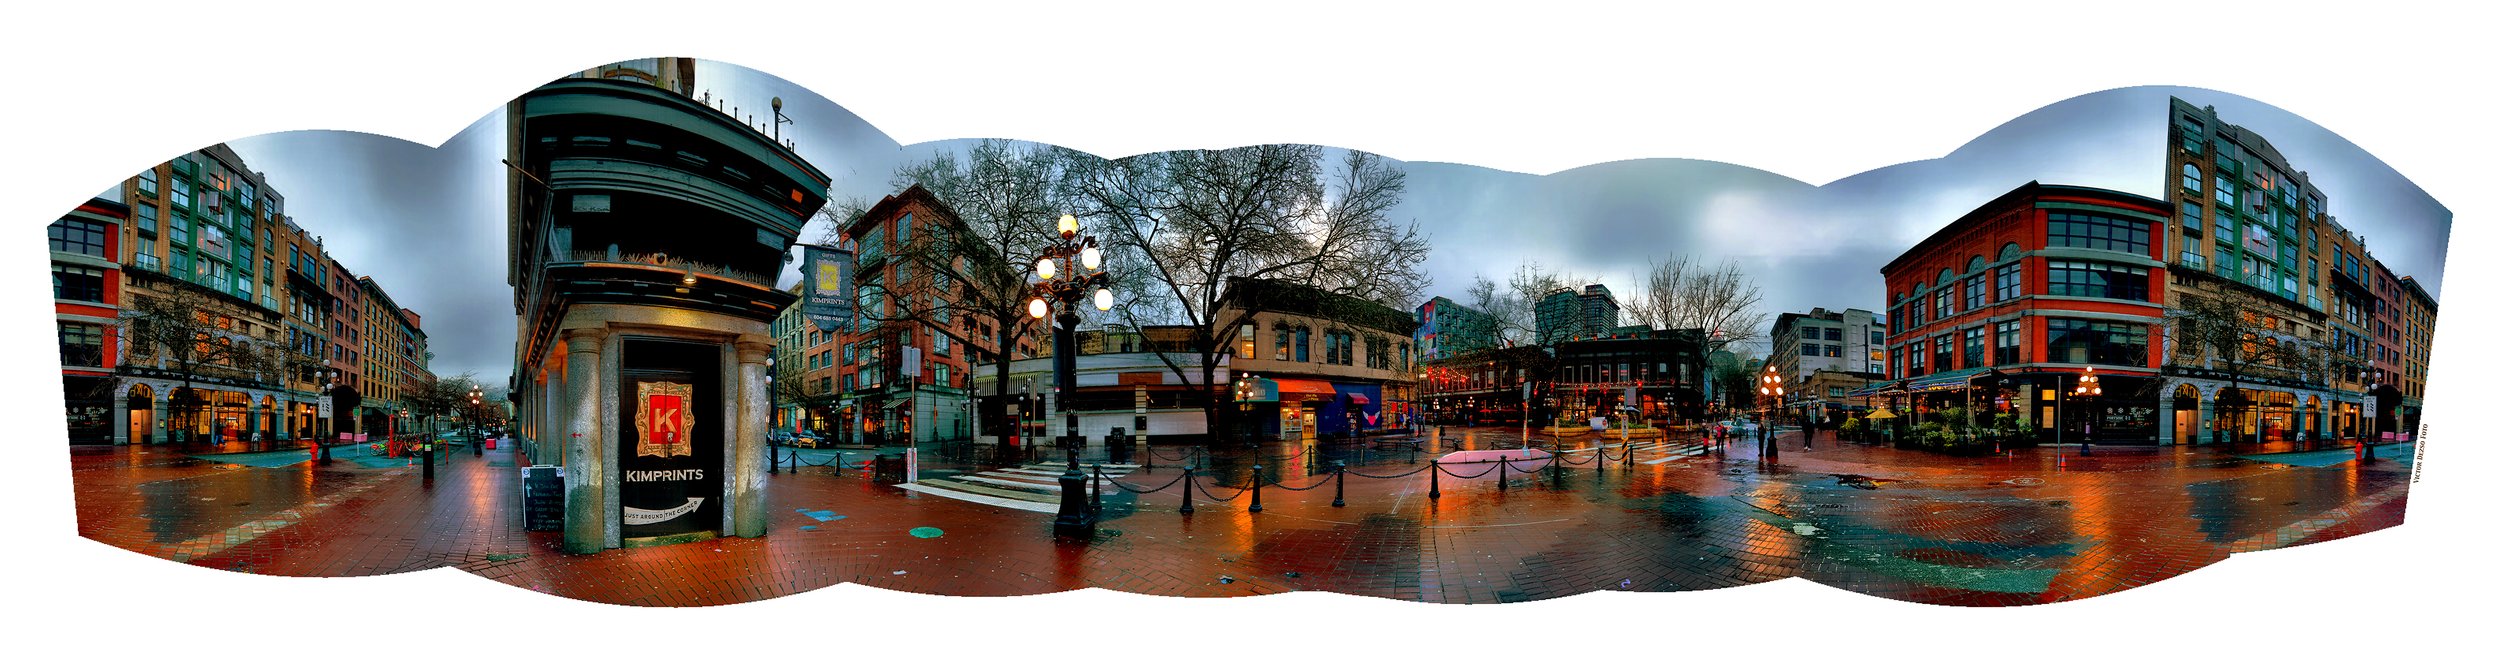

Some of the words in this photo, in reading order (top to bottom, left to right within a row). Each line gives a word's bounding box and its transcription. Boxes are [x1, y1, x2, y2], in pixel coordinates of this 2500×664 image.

[823, 271, 834, 284] K
[812, 297, 844, 305] KIMPRINTS
[654, 408, 678, 432] K
[626, 469, 704, 482] KIMPRINTS
[677, 501, 698, 514] CORNER
